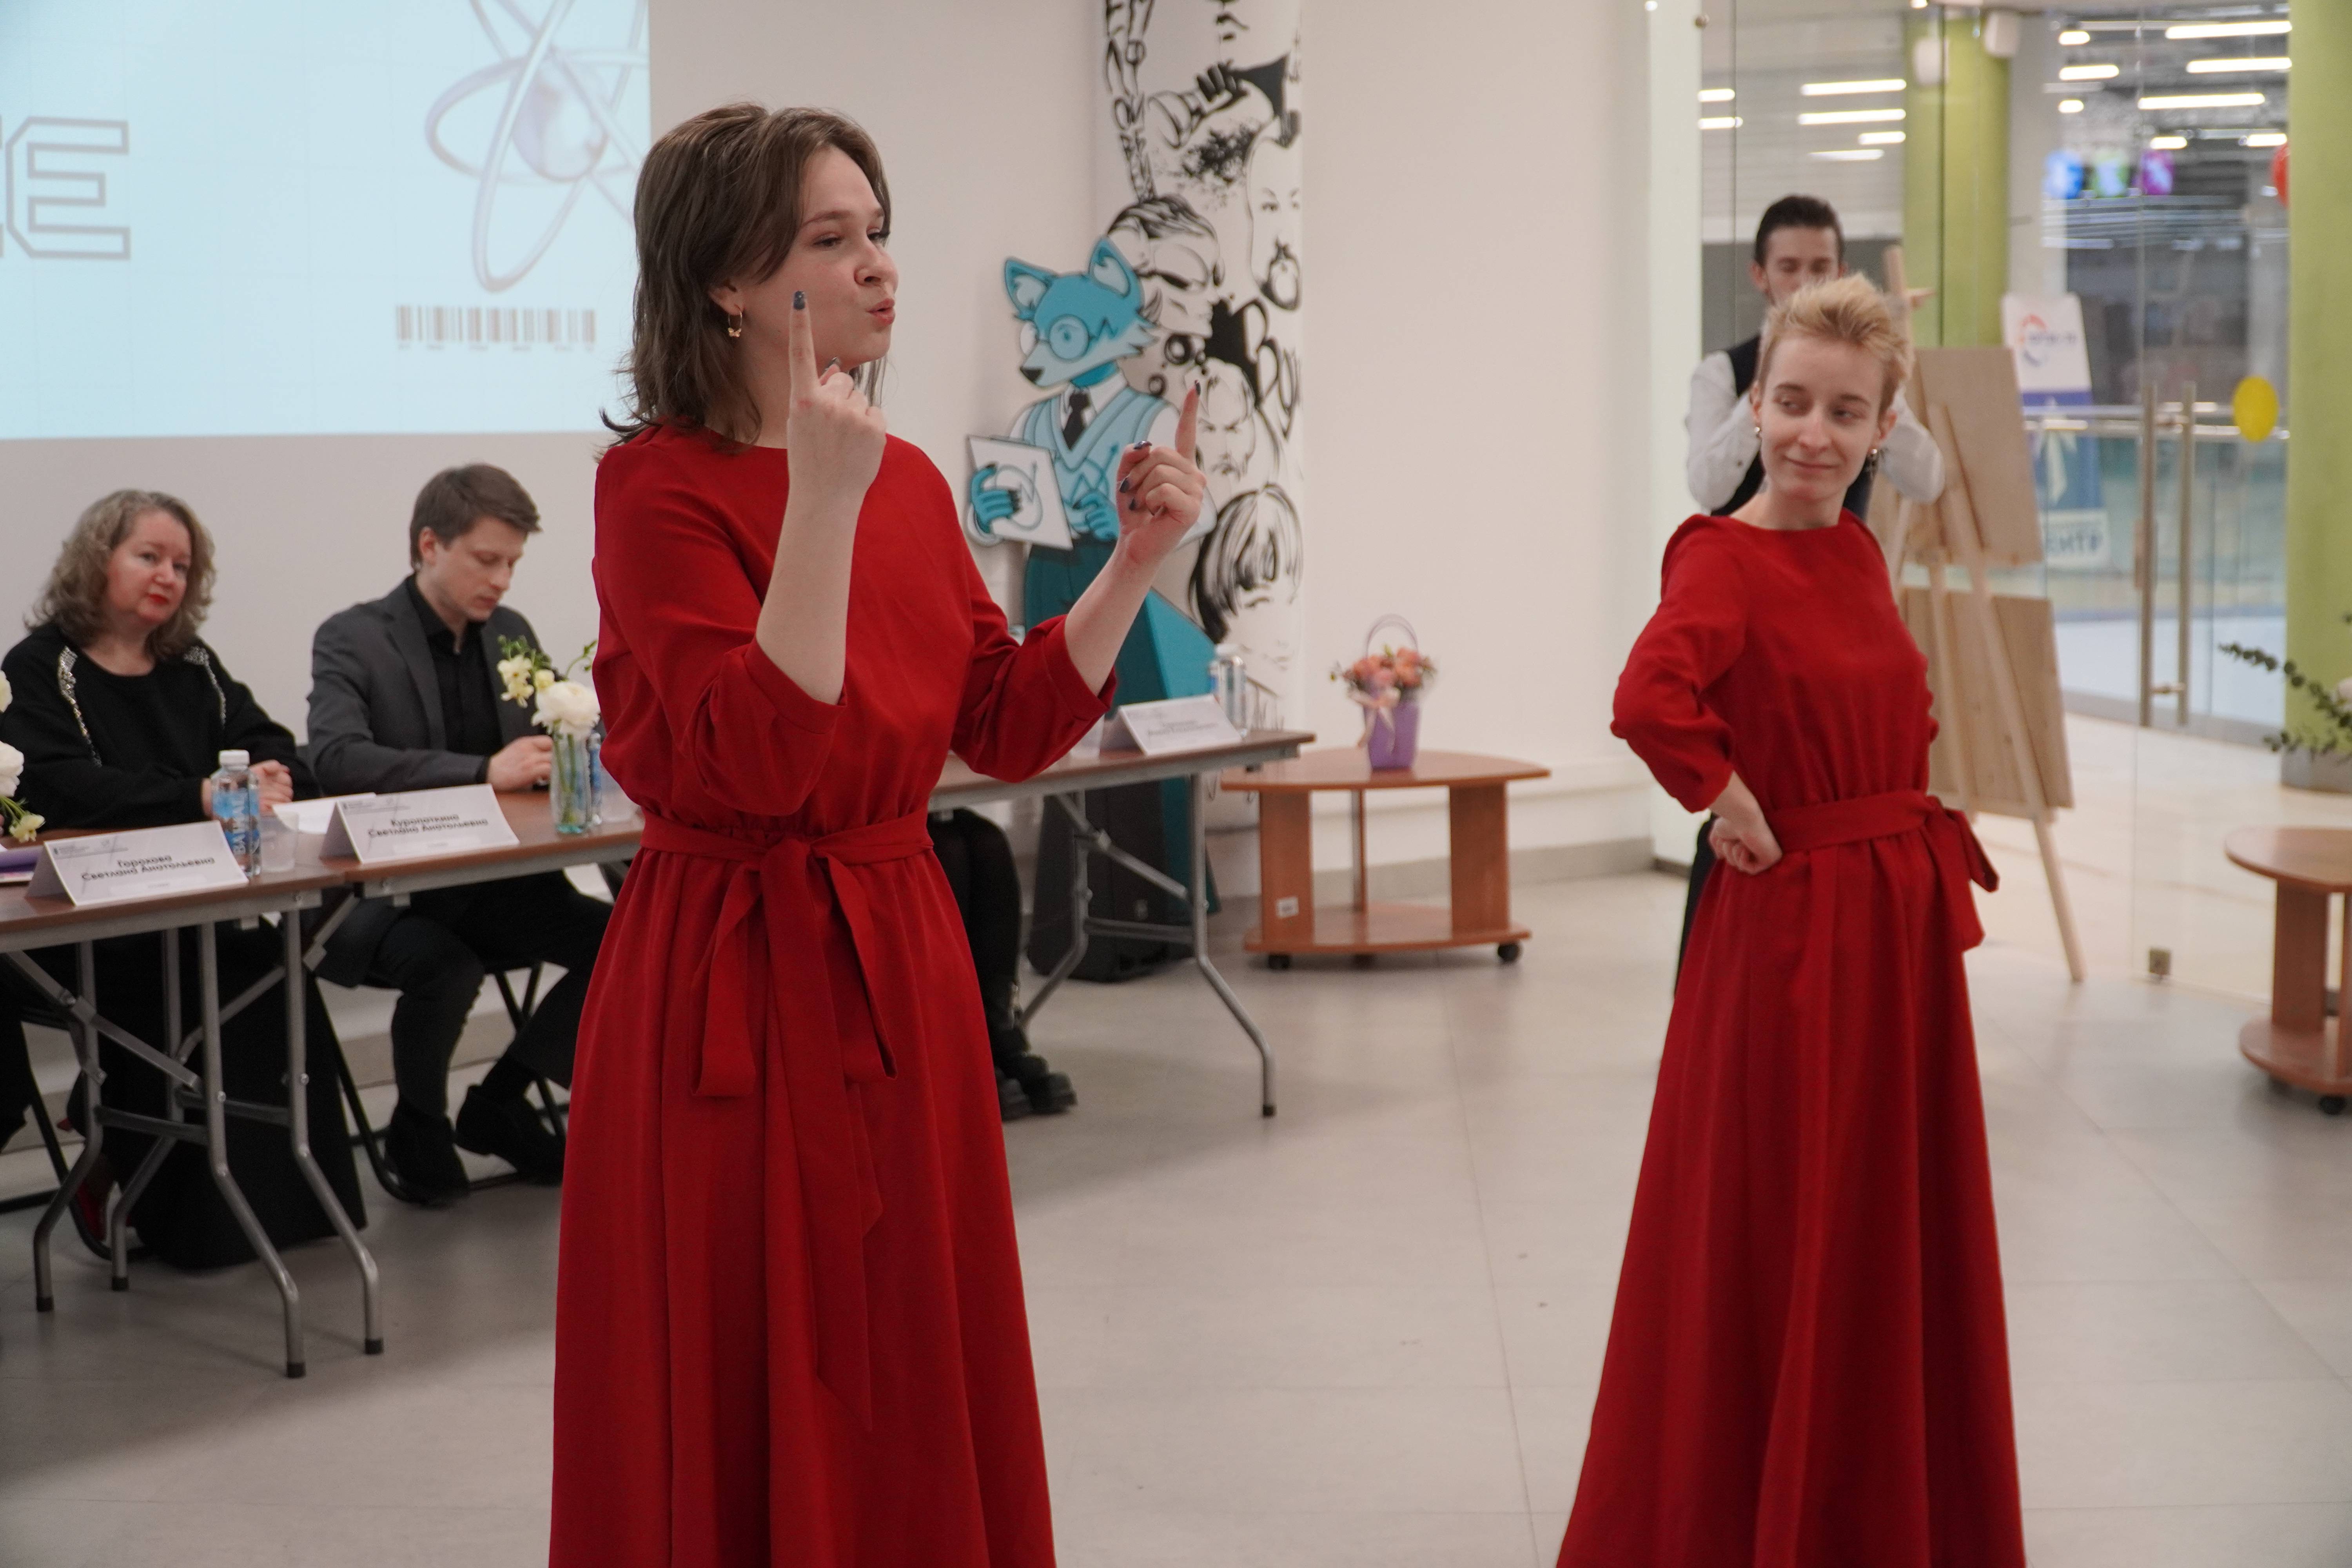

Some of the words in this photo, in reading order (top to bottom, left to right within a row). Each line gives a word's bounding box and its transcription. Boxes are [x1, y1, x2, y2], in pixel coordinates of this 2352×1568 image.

[0, 116, 131, 261] E
[368, 826, 419, 838] Светлана
[422, 818, 488, 832] Анатольевна
[391, 813, 459, 827] Куропаткина
[81, 867, 138, 881] Светлана
[142, 857, 215, 873] Анатольевна
[117, 854, 172, 867] Горохова
